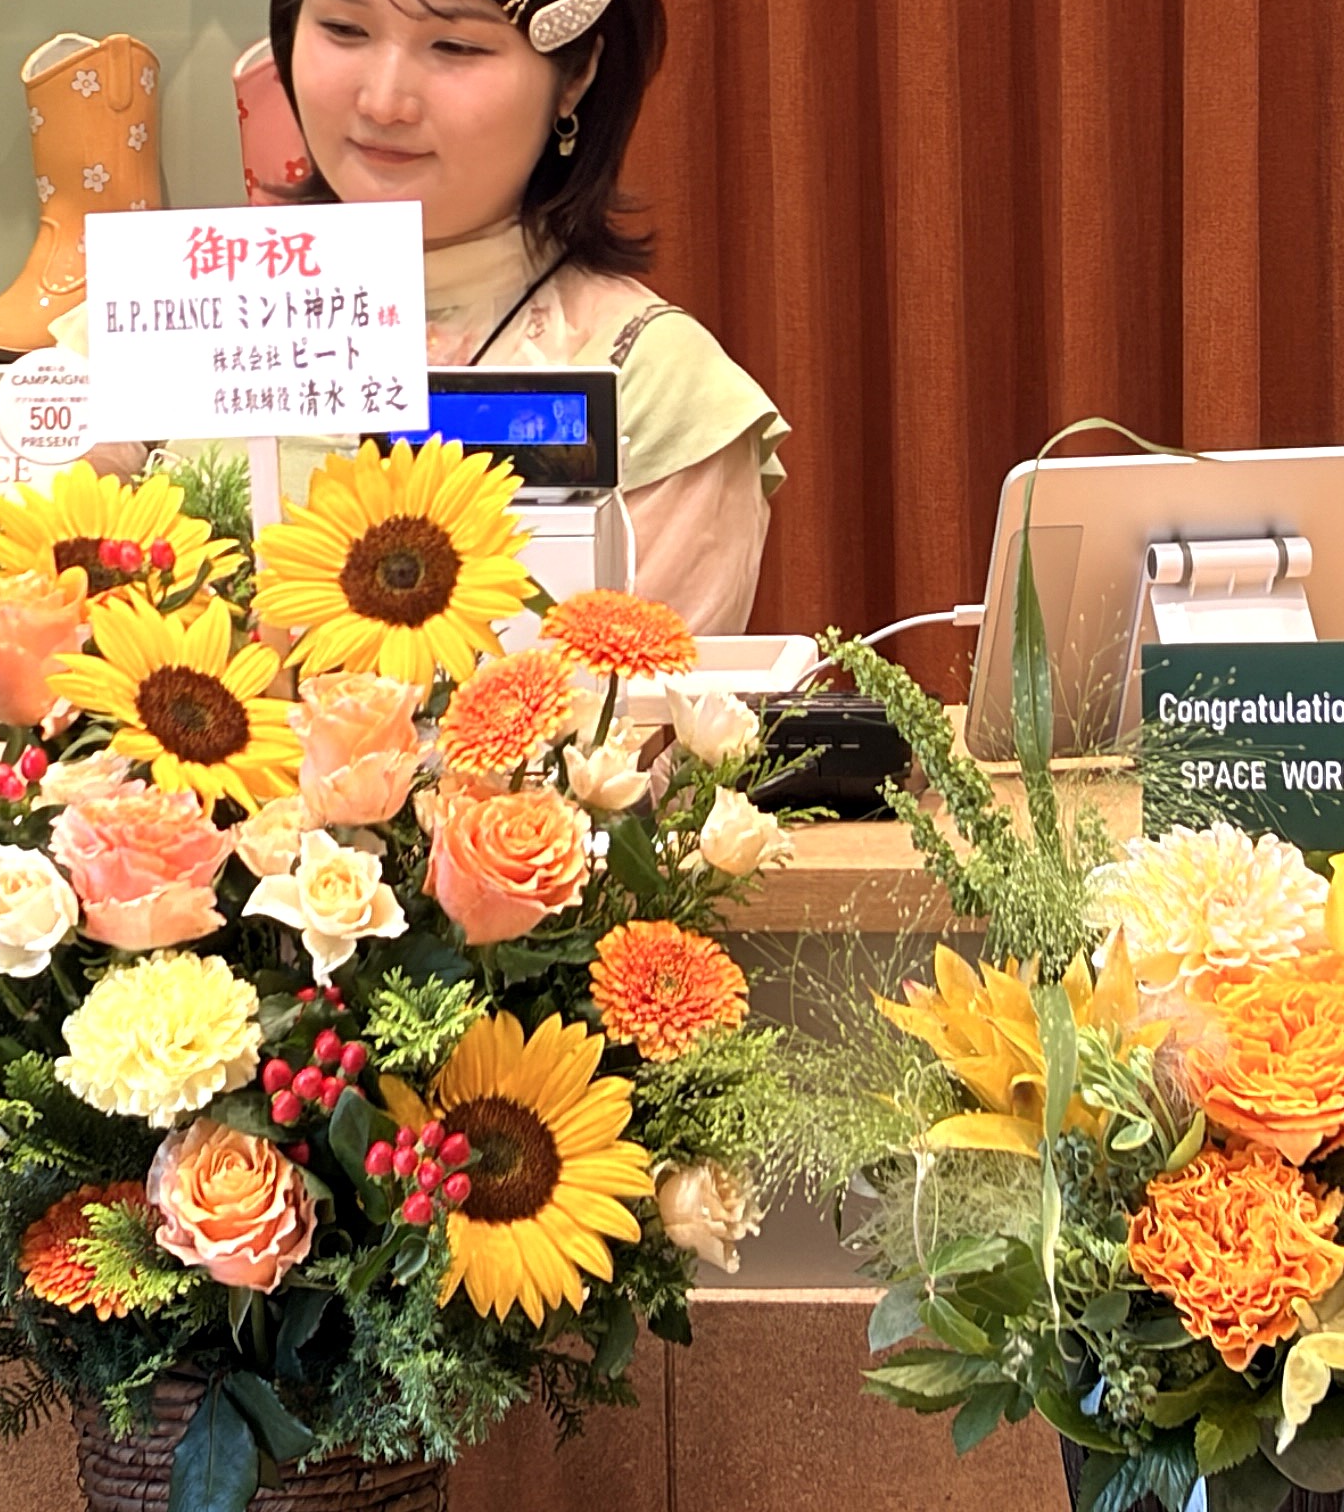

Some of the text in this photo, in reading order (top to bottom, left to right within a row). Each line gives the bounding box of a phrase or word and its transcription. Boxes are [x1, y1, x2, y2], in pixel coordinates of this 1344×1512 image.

[182, 226, 322, 282] 御祝
[299, 378, 345, 417] 清水
[360, 374, 408, 414] 宏之
[30, 405, 72, 431] 500
[21, 436, 81, 448] PRESENT
[1180, 760, 1267, 790] SPACE
